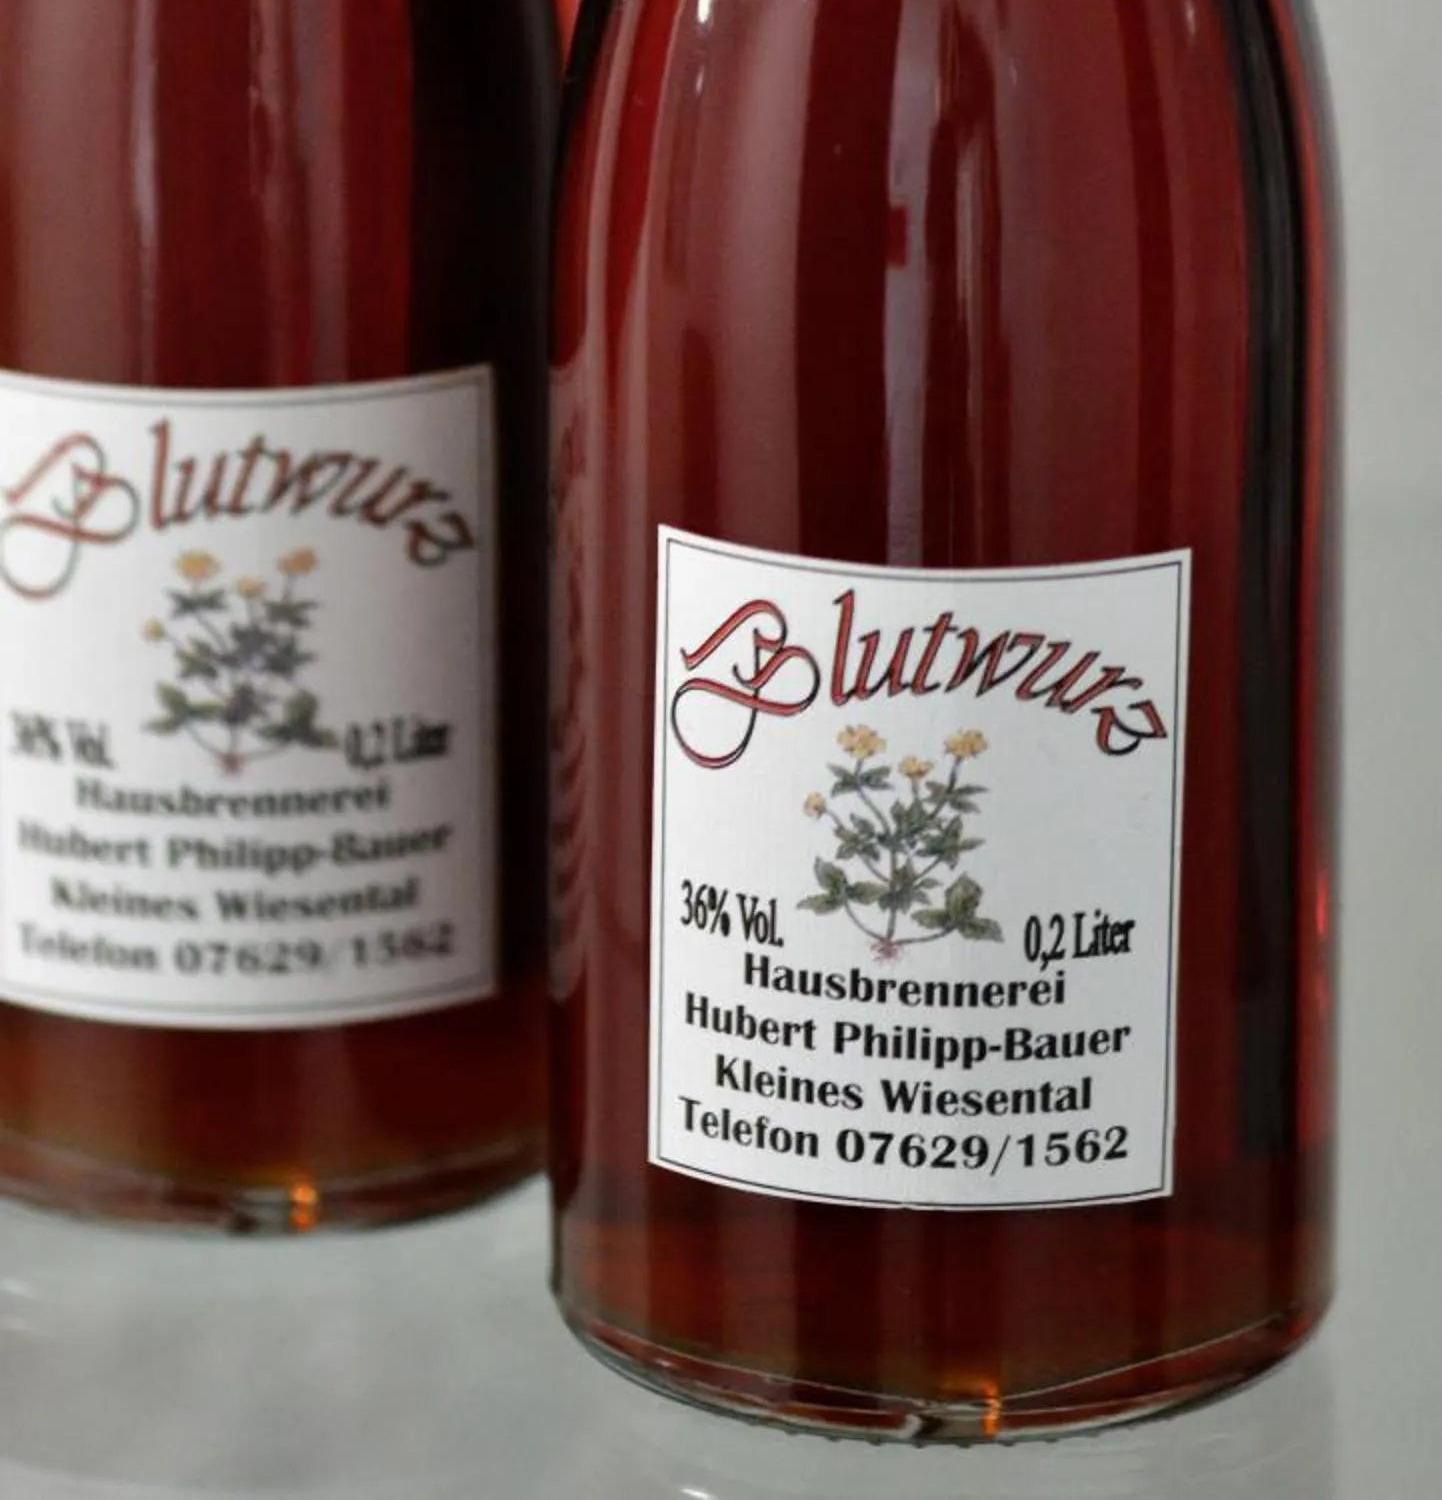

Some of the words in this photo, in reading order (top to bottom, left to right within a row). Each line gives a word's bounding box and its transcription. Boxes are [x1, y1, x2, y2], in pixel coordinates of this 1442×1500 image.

[0, 418, 475, 601] Blutwurz
[671, 588, 1168, 769] Blutwurz
[75, 777, 390, 818] Hausbrennerei
[17, 819, 151, 868] Hubert
[167, 823, 452, 876] Philipp-Bauer
[50, 876, 199, 920] Kleines
[213, 876, 419, 921] Wiesental
[679, 879, 731, 938] 36%
[736, 893, 784, 948] Vol.
[17, 922, 157, 972] Telefon
[1024, 914, 1066, 970] 0,2
[1073, 908, 1136, 959] Liter
[743, 952, 1066, 1007] Hausbrennerei
[684, 991, 817, 1051] Hubert
[833, 1021, 1131, 1070] Philipp-Bauer
[715, 1053, 864, 1111] Kleines
[880, 1076, 1093, 1118] Wiesental
[679, 1096, 819, 1159] Telefon
[835, 1125, 1129, 1176] 07629/1562
